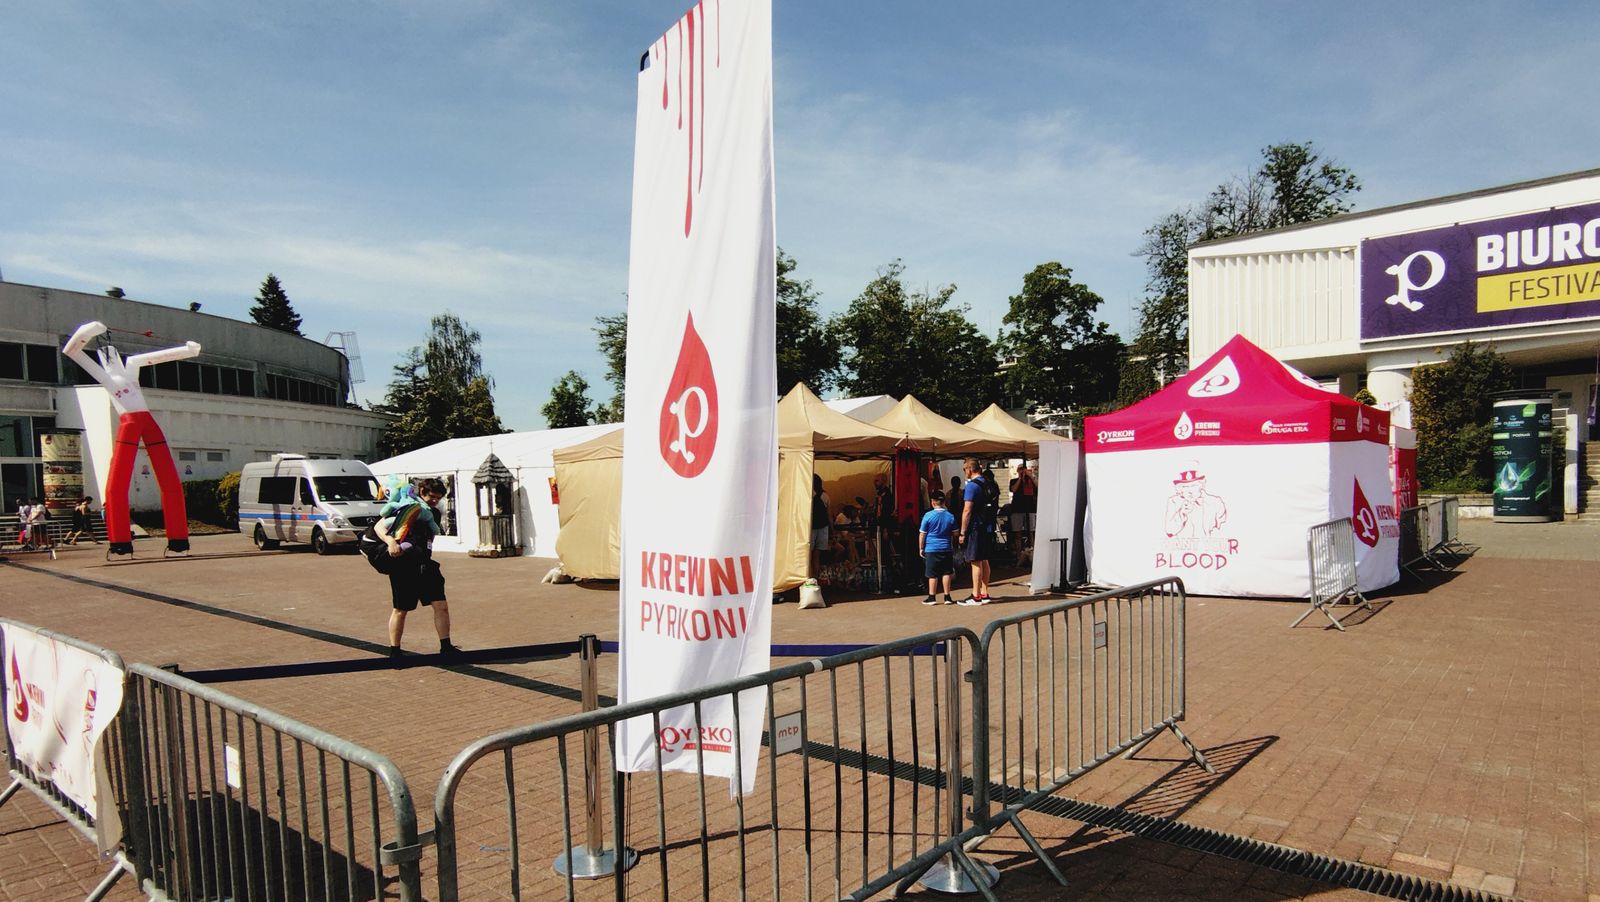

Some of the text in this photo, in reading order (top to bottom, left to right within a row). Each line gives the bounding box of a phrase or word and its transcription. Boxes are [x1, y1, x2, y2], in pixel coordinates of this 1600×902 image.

[1097, 430, 1135, 443] PYRKON
[1155, 552, 1227, 570] BLOOD
[641, 550, 754, 596] KREWNI
[778, 725, 799, 738] mtp
